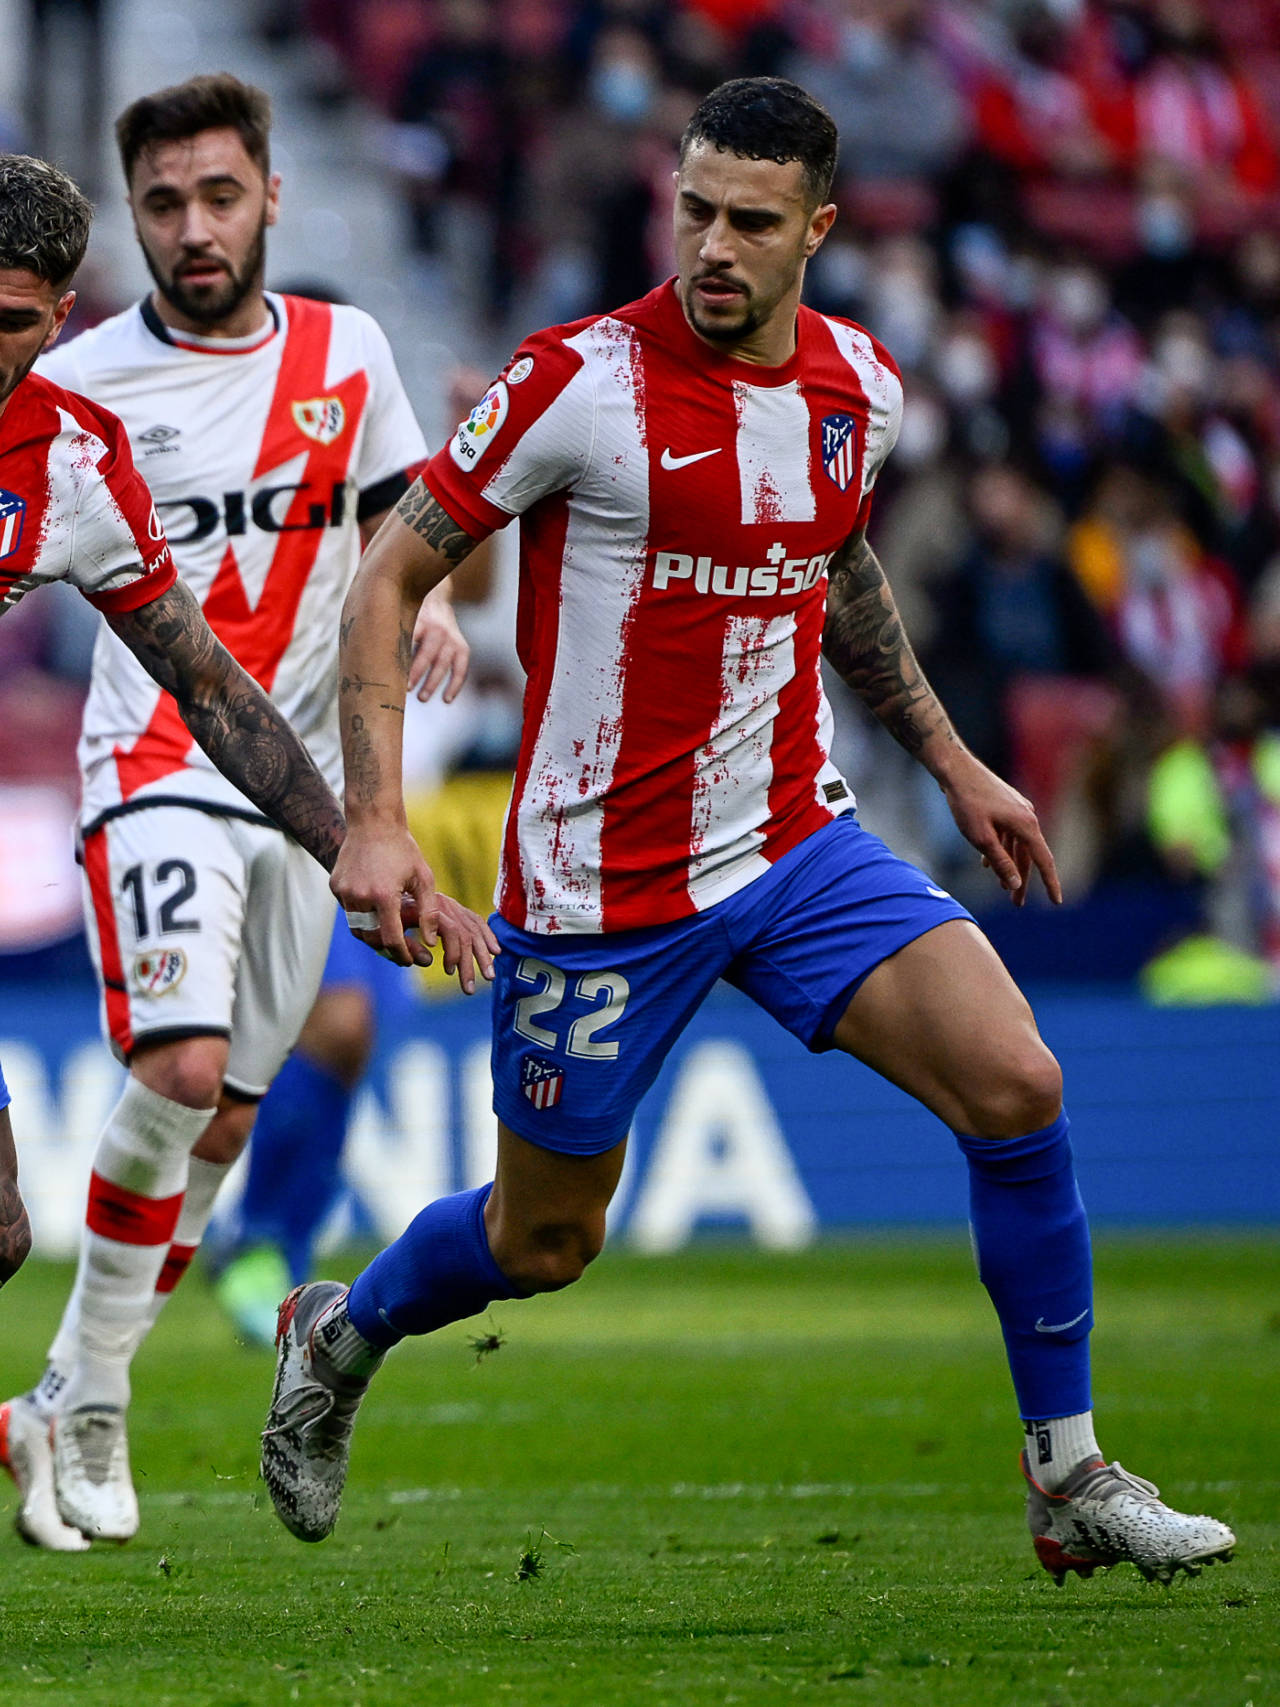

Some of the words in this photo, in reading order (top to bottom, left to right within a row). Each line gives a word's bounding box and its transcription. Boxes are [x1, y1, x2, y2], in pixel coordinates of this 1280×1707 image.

[154, 482, 347, 544] DIGI
[121, 857, 202, 942] 12
[513, 956, 630, 1061] 22
